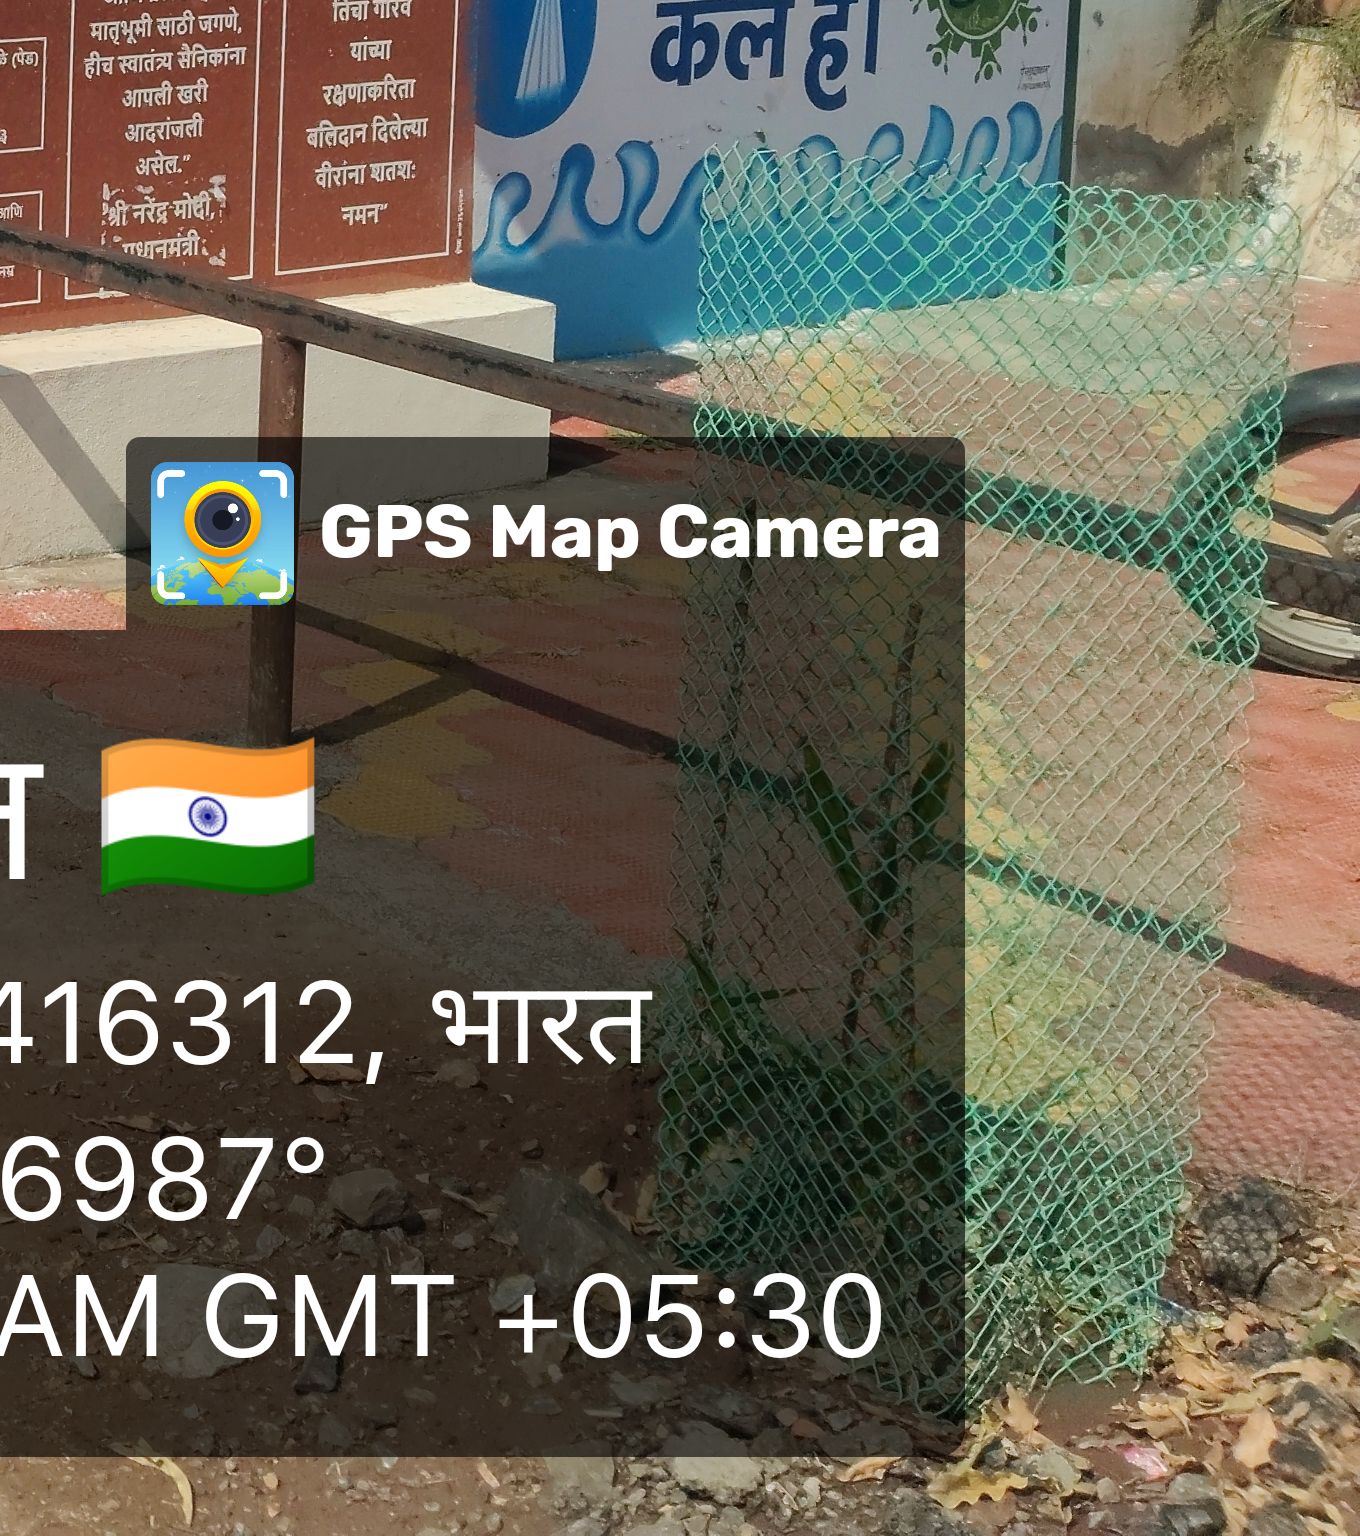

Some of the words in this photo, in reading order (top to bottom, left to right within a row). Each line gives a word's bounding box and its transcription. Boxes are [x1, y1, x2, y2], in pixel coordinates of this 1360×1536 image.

[88, 12, 153, 46] मातृभूमी
[156, 9, 196, 37] साठी
[198, 6, 243, 34] जगणे,
[12, 47, 39, 69] (पेड)
[84, 50, 114, 80] हीच
[117, 48, 174, 74] स्वातंत्र्य
[177, 42, 247, 69] सैनिकांना
[349, 35, 393, 61] यांच्या
[122, 80, 173, 108] आपली
[176, 77, 209, 104] खरी
[322, 73, 417, 106] रक्षणाकरिता
[124, 112, 205, 143] आदरांजली
[306, 119, 368, 148] बलिदान
[371, 113, 429, 143] दिलेल्या
[315, 160, 367, 189] वीरांना
[370, 160, 416, 183] शतशः
[108, 198, 129, 227] श्री
[131, 195, 170, 225] नरेंद्र
[173, 190, 216, 221] मोदी,
